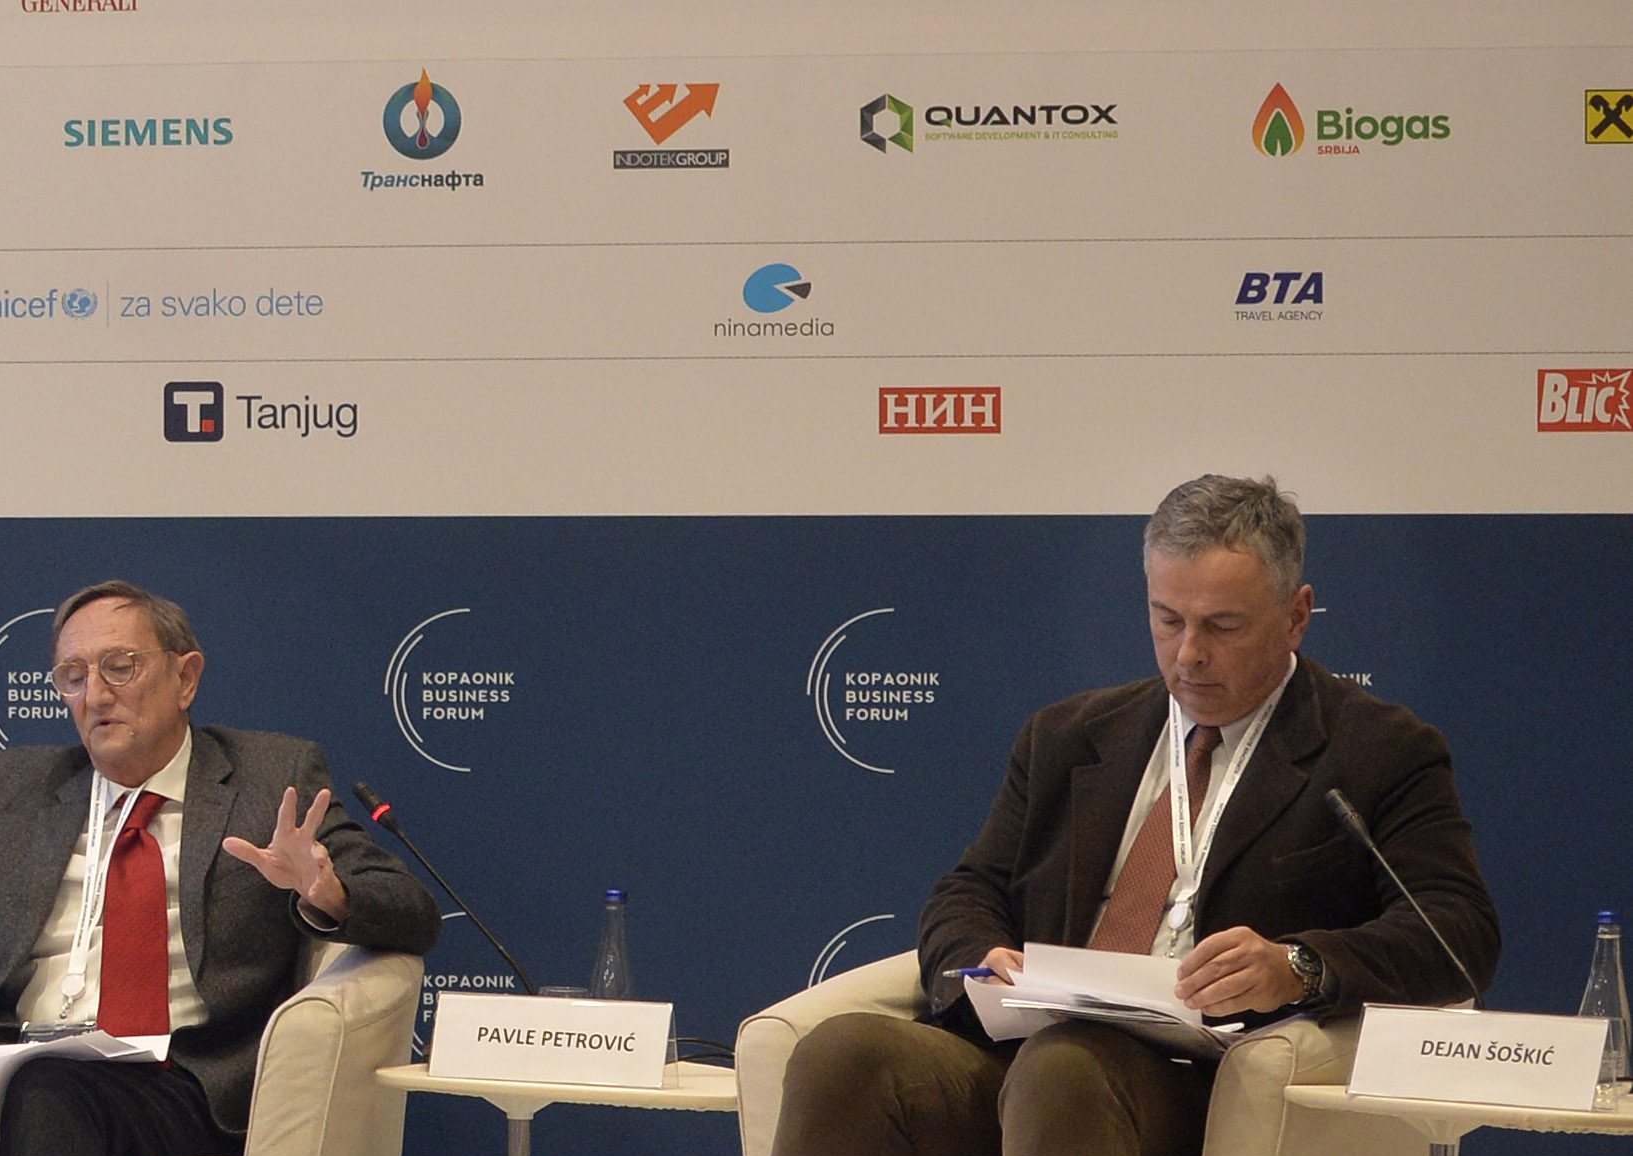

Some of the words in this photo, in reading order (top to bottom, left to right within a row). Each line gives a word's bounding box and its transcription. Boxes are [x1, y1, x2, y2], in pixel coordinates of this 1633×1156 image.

[925, 105, 1117, 127] QUANTOX
[64, 118, 233, 147] SIEMENS
[1317, 107, 1451, 146] Biogas
[925, 131, 973, 141] SOFTWARE
[975, 131, 1041, 140] DEVELOPMENT
[1052, 131, 1060, 140] IT
[1062, 130, 1119, 139] CONSULTING
[1318, 146, 1360, 154] SRBIJA
[361, 170, 483, 191] Транснафта
[1235, 272, 1323, 304] BTA
[121, 297, 150, 317] za
[162, 288, 246, 317] svako
[256, 288, 323, 316] dete
[1235, 311, 1274, 321] TRAVEL
[1278, 311, 1323, 320] AGENCY
[715, 318, 834, 336] ninamedia
[236, 396, 358, 437] Tanjug
[883, 393, 997, 428] НИН
[8, 672, 53, 684] KOPA
[423, 673, 514, 684] KOPAONIK
[846, 673, 939, 685] KOPAONIK
[8, 689, 61, 701] BUSIN
[423, 690, 509, 702] BUSINESS
[846, 691, 934, 703] BUSINESS
[8, 707, 68, 719] FORUM
[423, 708, 483, 719] FORUM
[846, 708, 907, 720] FORUM
[424, 975, 515, 988] KOPAONIK
[477, 1026, 537, 1045] PAVLE
[541, 1030, 636, 1052] PETROVIĆ
[1420, 1039, 1482, 1059] DEJAN
[1485, 1040, 1555, 1065] ŠOŠKIĆ
